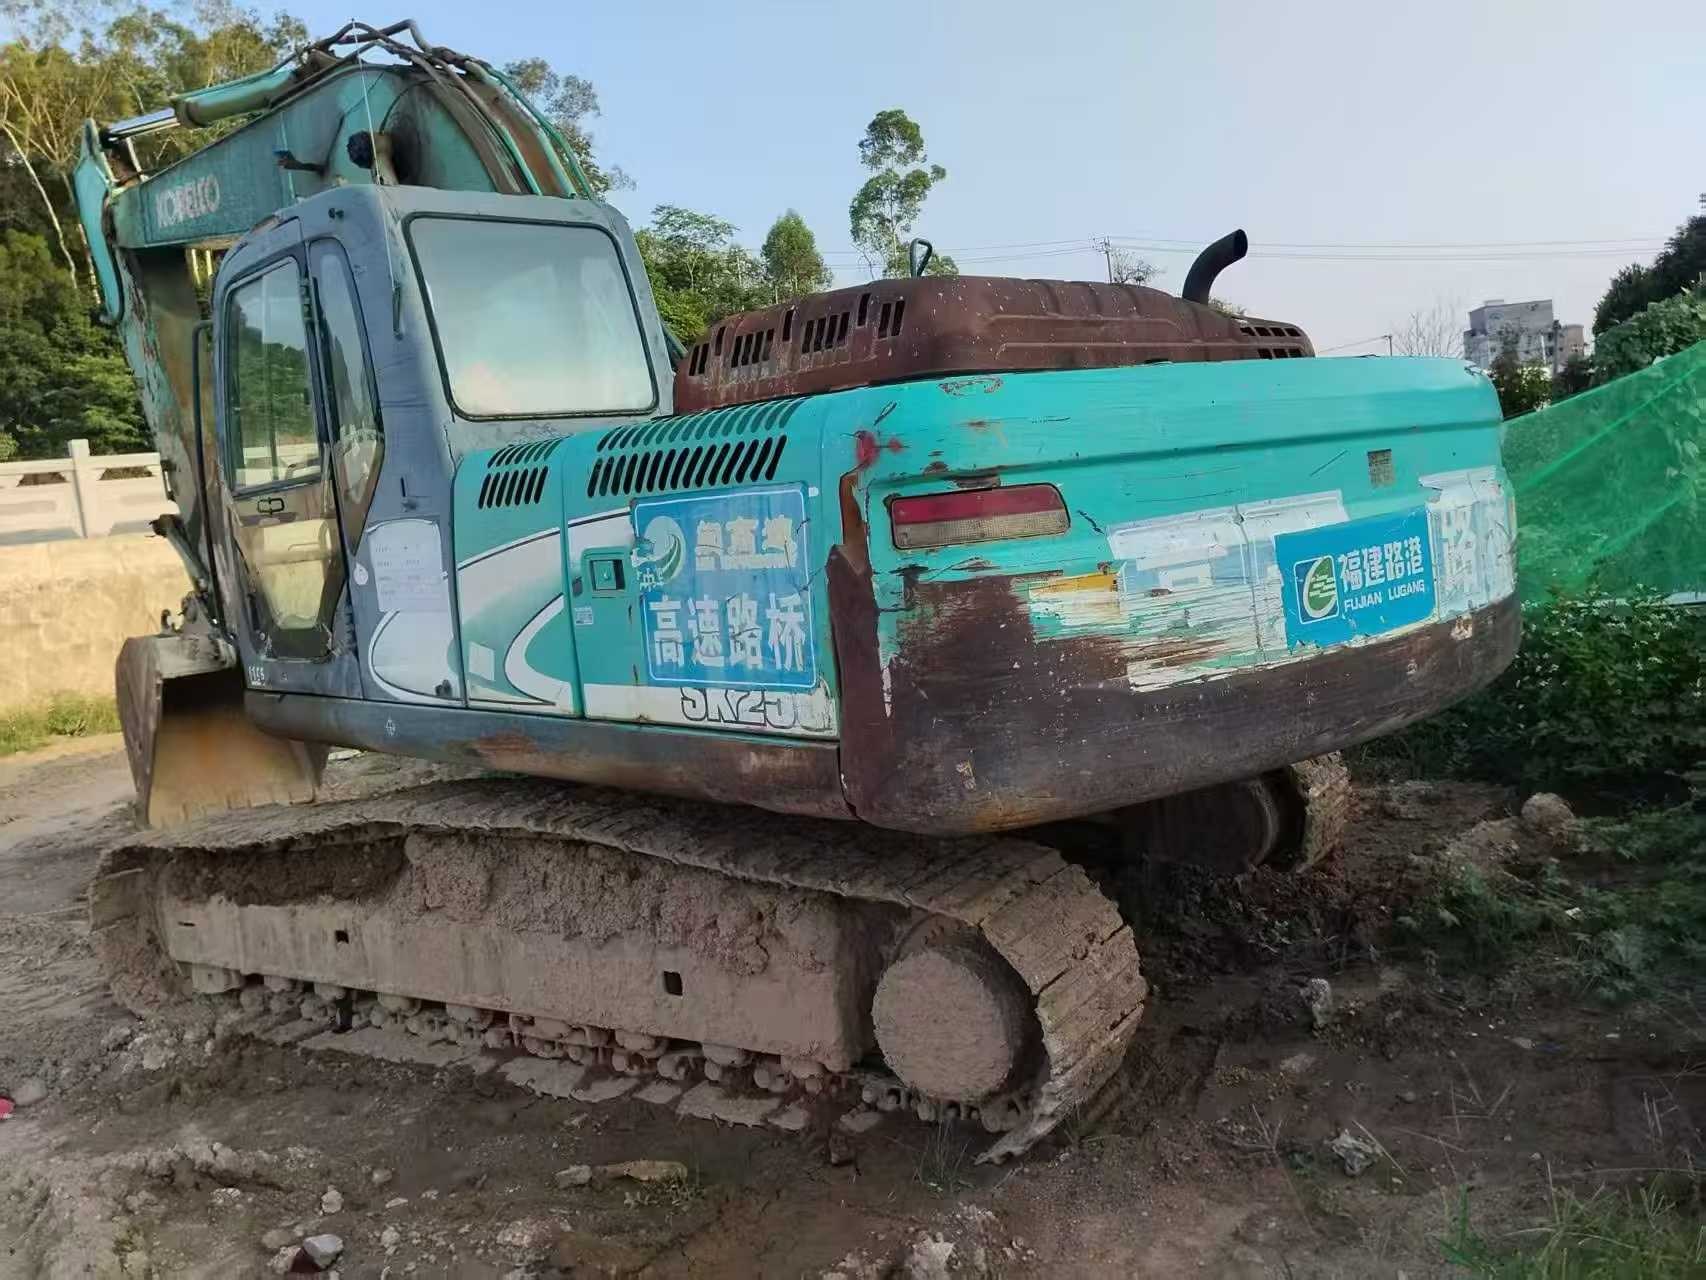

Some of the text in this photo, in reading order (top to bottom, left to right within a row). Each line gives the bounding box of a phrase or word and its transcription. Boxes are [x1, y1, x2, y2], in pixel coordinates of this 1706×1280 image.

[1338, 536, 1424, 593] 福建路港
[1344, 579, 1425, 612] FUJIAN LUGANG
[649, 592, 806, 671] 高速路桥
